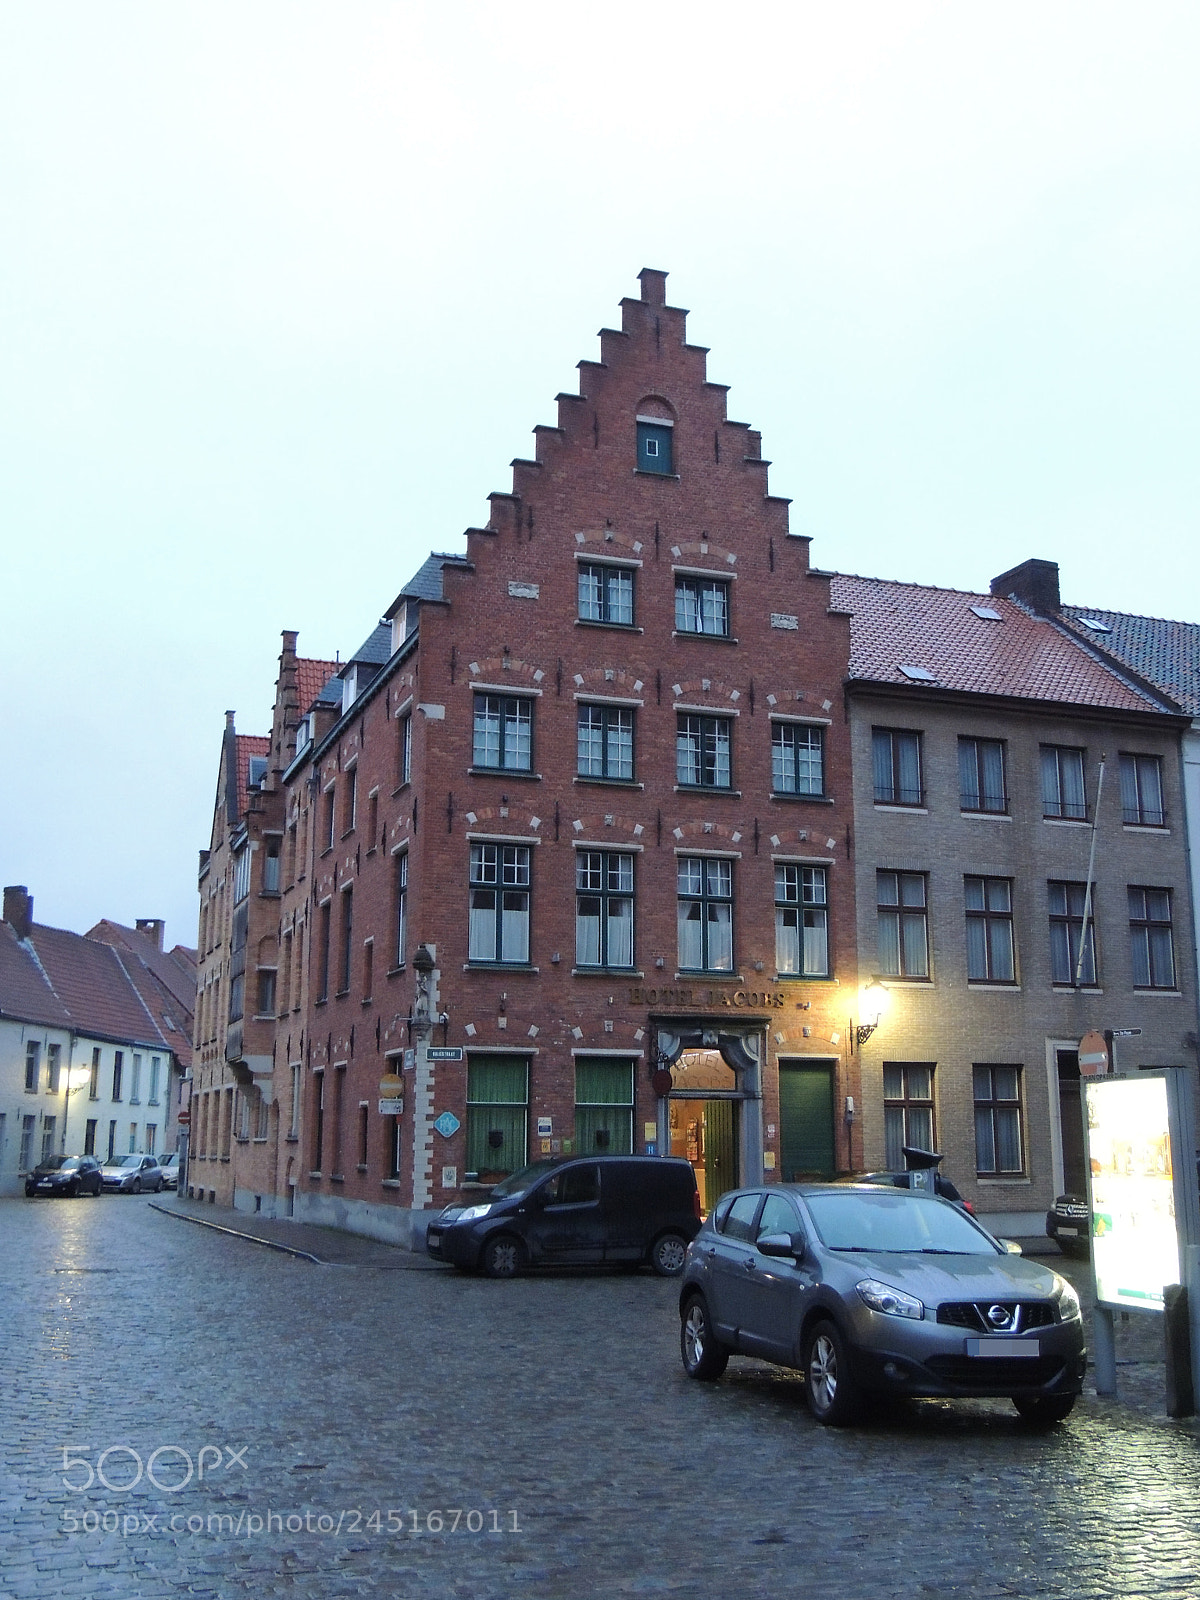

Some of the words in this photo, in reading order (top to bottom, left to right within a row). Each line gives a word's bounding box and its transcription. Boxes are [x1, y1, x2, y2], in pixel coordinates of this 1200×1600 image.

[629, 988, 699, 1006] HOTEL
[705, 990, 785, 1008] JACOBS
[673, 1053, 722, 1073] HOTEL
[672, 1075, 731, 1088] JACOBS
[913, 1172, 923, 1188] P
